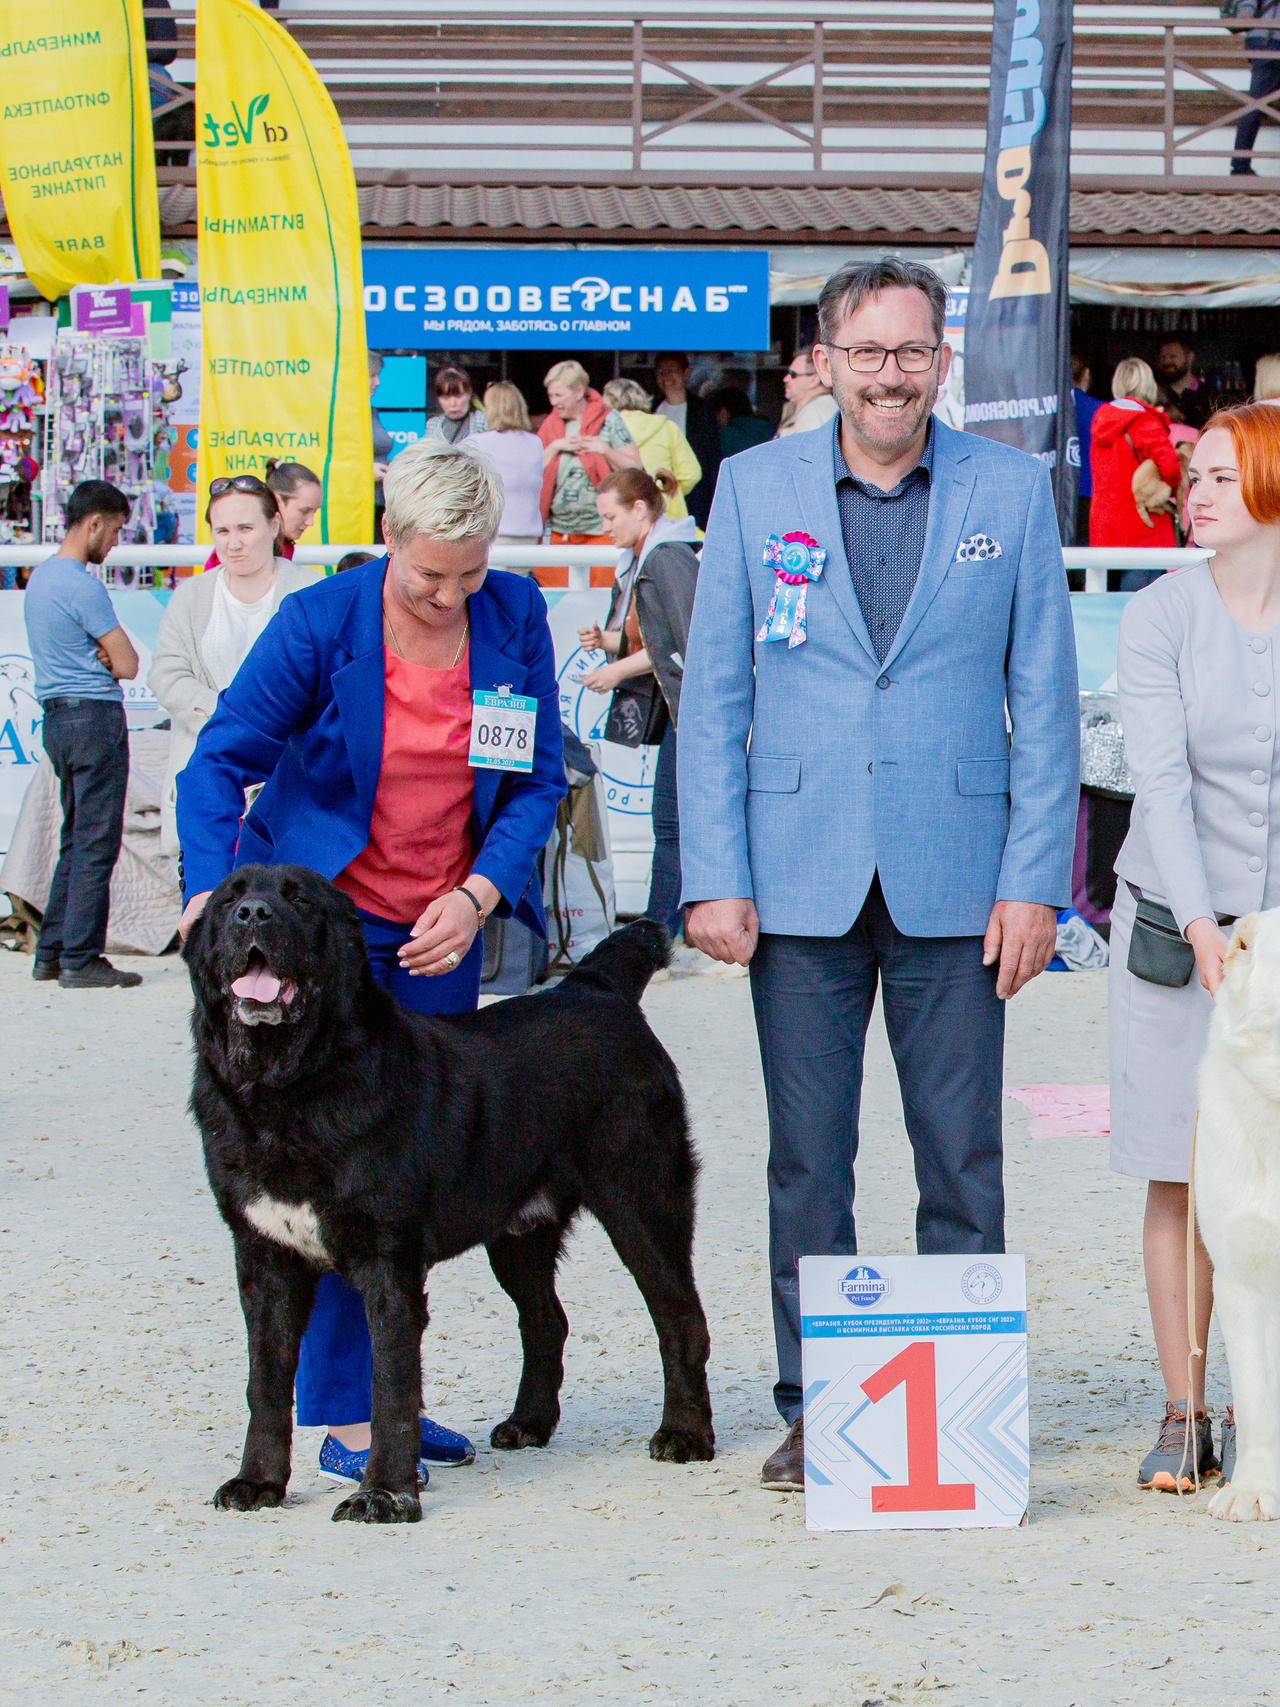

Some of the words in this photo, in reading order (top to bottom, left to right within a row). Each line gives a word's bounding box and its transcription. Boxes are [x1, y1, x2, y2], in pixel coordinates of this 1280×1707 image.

[423, 320, 445, 331] МЫ
[447, 320, 494, 333] РЯДОМ,
[496, 320, 558, 332] ЗАБОТЯСЬ
[559, 320, 570, 331] О
[572, 320, 631, 331] ГЛАВНОМ
[484, 697, 526, 710] ЕВРАЗИЯ
[478, 724, 528, 749] 0878
[841, 1281, 886, 1292] Farmina
[860, 1342, 976, 1513] 1
